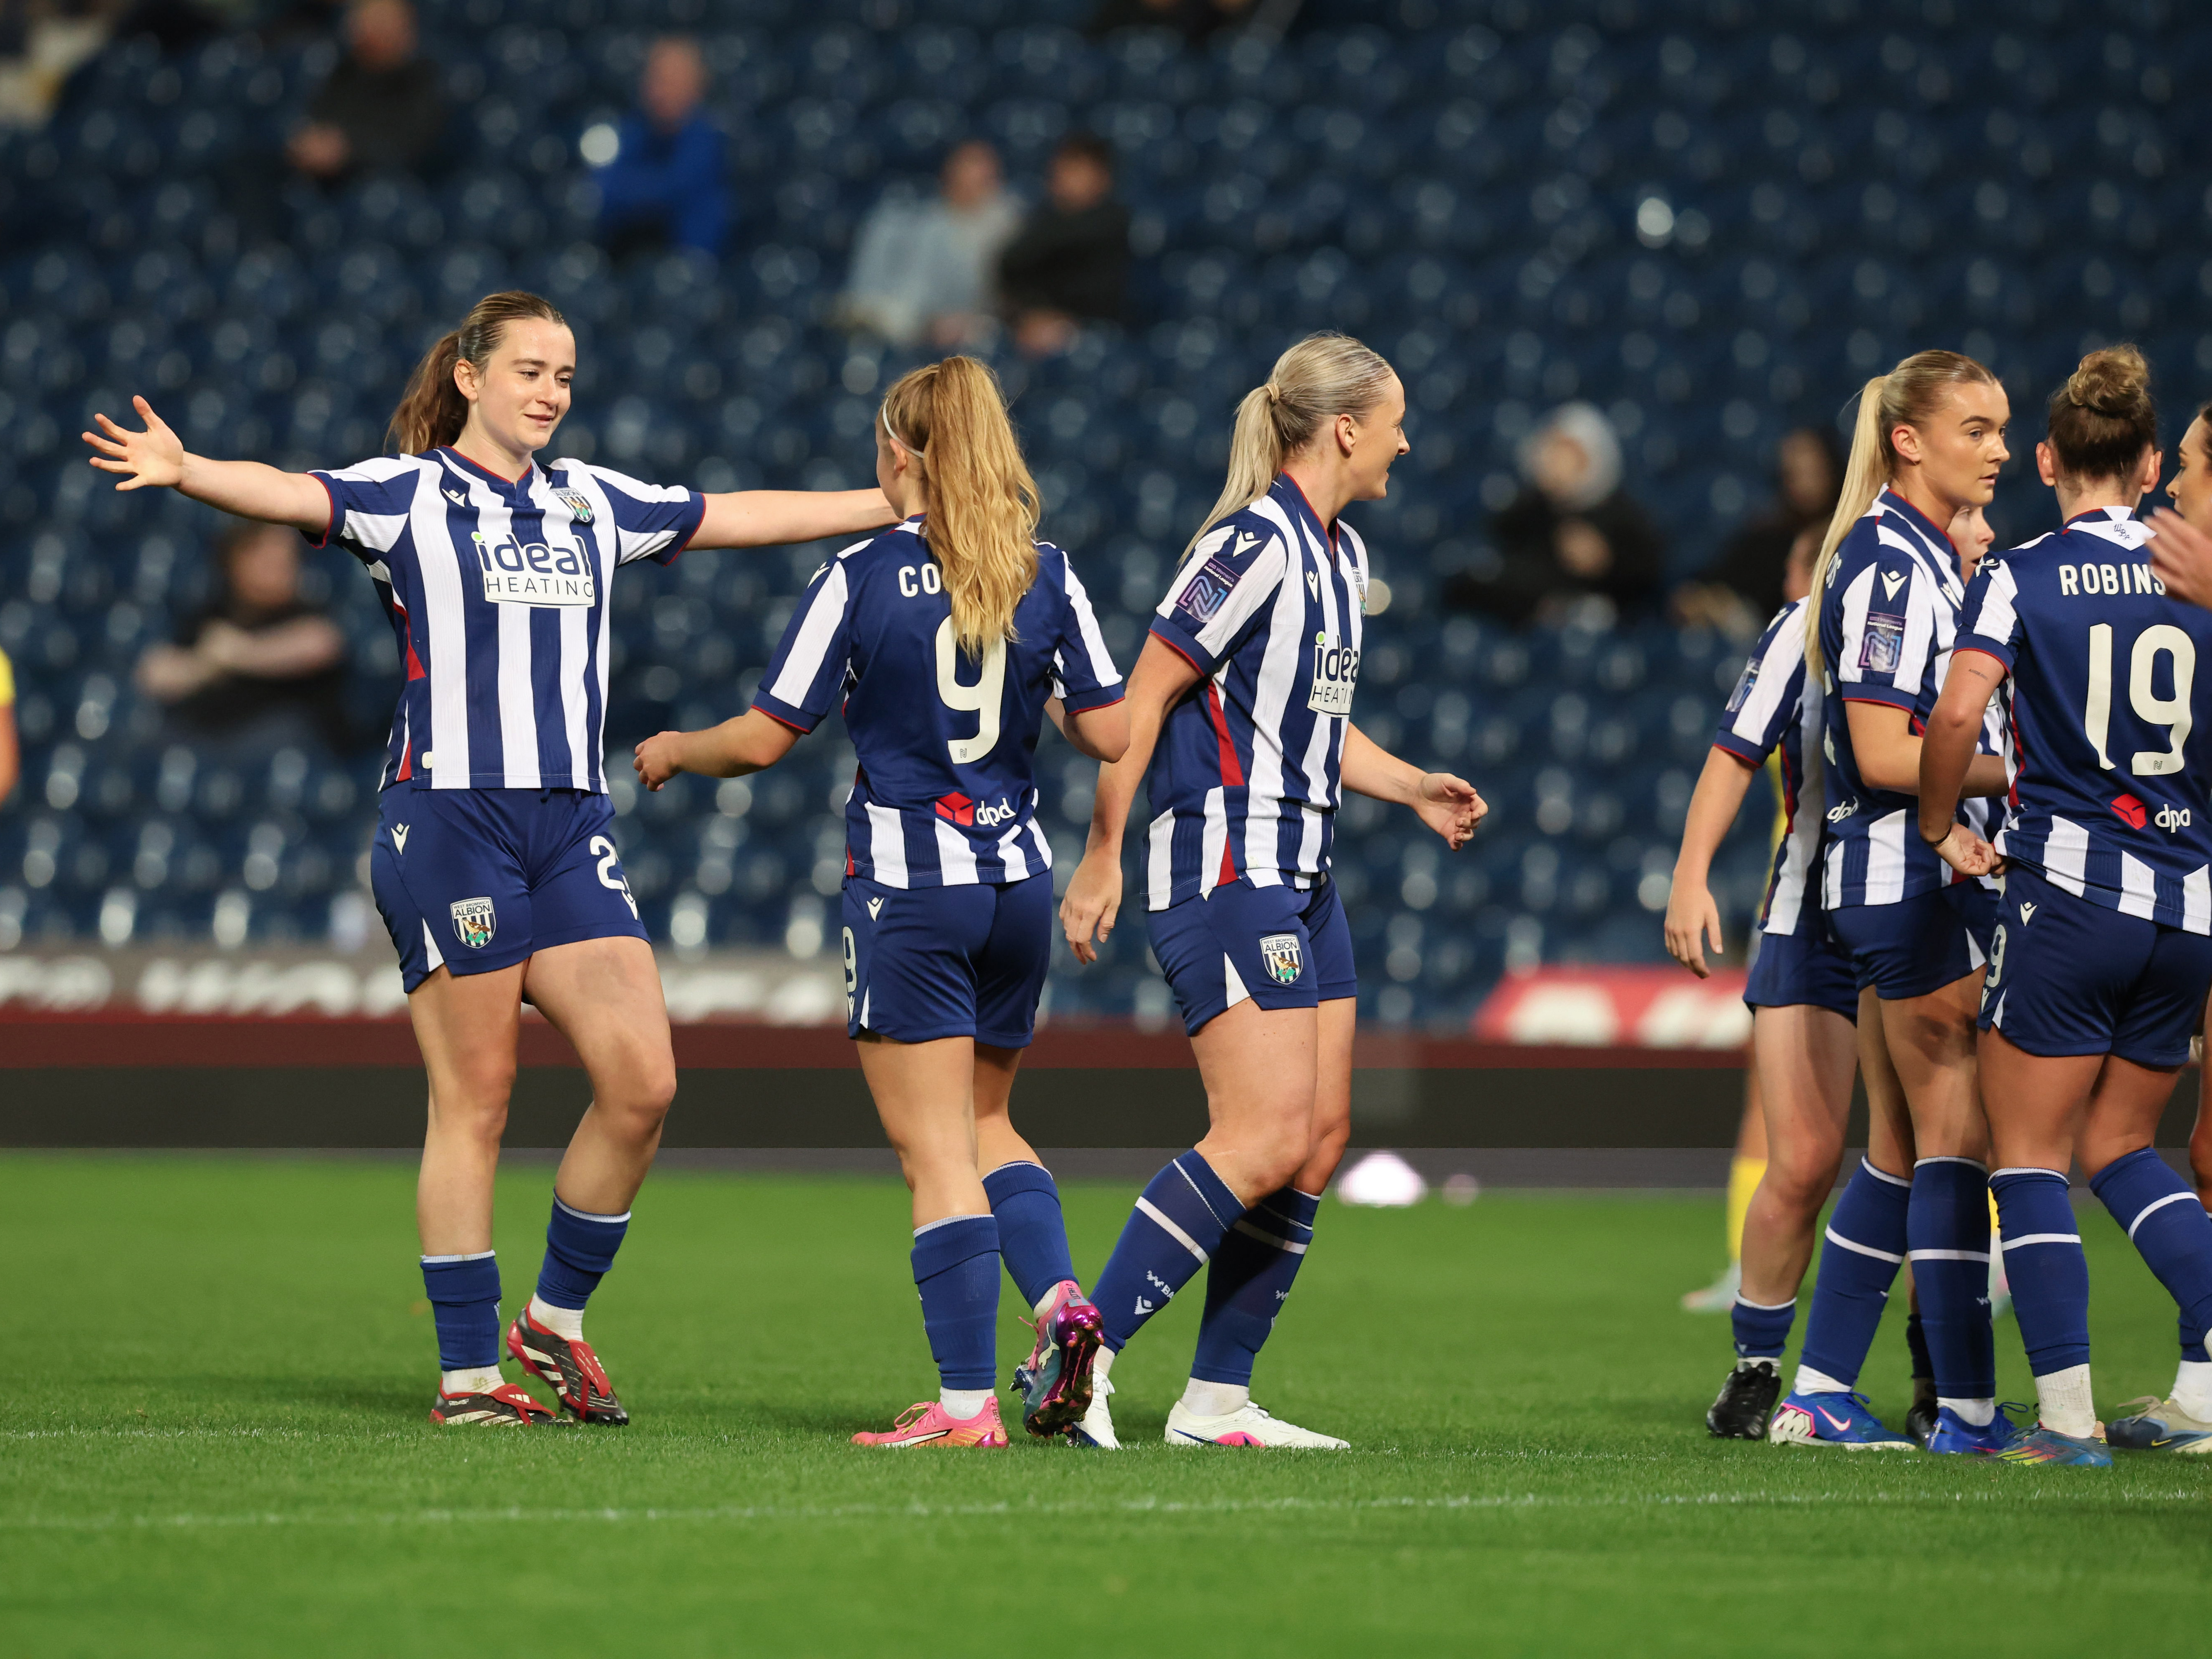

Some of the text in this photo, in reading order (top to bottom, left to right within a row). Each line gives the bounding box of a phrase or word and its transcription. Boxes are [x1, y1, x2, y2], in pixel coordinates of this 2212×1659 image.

[474, 533, 591, 577] ideal
[486, 577, 594, 597] HEATING
[1204, 565, 1220, 578] National
[1218, 575, 1233, 588] League
[1216, 567, 1234, 583] Women's
[2059, 563, 2166, 596] ROBINS
[1316, 633, 1359, 684] idea
[935, 614, 1007, 764] 9
[2084, 623, 2196, 776] 19
[976, 797, 1017, 827] dpd
[455, 904, 491, 917] ALBION
[1265, 941, 1297, 952] ALBION
